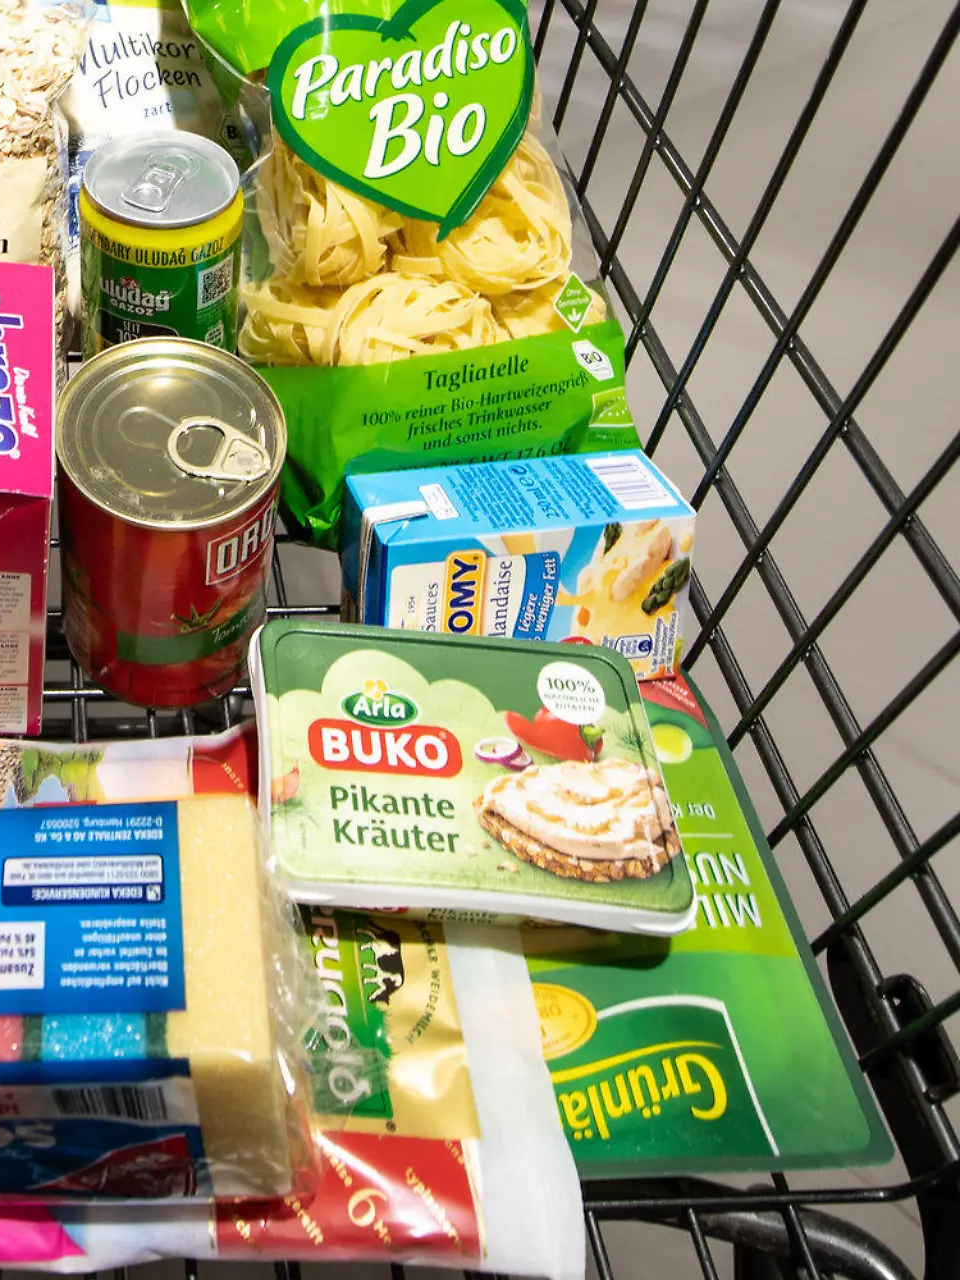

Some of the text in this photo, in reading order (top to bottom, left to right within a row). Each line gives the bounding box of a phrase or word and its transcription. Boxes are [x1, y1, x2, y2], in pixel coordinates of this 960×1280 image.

[80, 32, 204, 76] Multikor
[291, 20, 518, 120] Paradiso
[93, 63, 202, 109] Flocken
[143, 101, 173, 118] zart
[362, 91, 487, 179] Bio
[135, 247, 186, 265] ULUDAĞ
[191, 236, 224, 261] GAZOZ
[423, 355, 529, 392] Tagliatelle
[361, 410, 401, 427] 100%
[405, 404, 448, 421] reiner
[407, 399, 553, 440] frisches Trinkwasser
[422, 420, 543, 451] und sonst nichts.
[448, 555, 478, 634] OMY
[487, 560, 513, 638] landaise
[517, 592, 538, 632] légère
[534, 582, 555, 632] weniger
[545, 677, 596, 694] 100%
[352, 697, 407, 719] Arla
[321, 728, 448, 770] BUKO
[329, 785, 456, 819] Pikante
[333, 818, 459, 854] Kräuter
[111, 885, 143, 899] EDEKA
[696, 893, 762, 929] MIL
[559, 1051, 728, 1142] Grünlä
